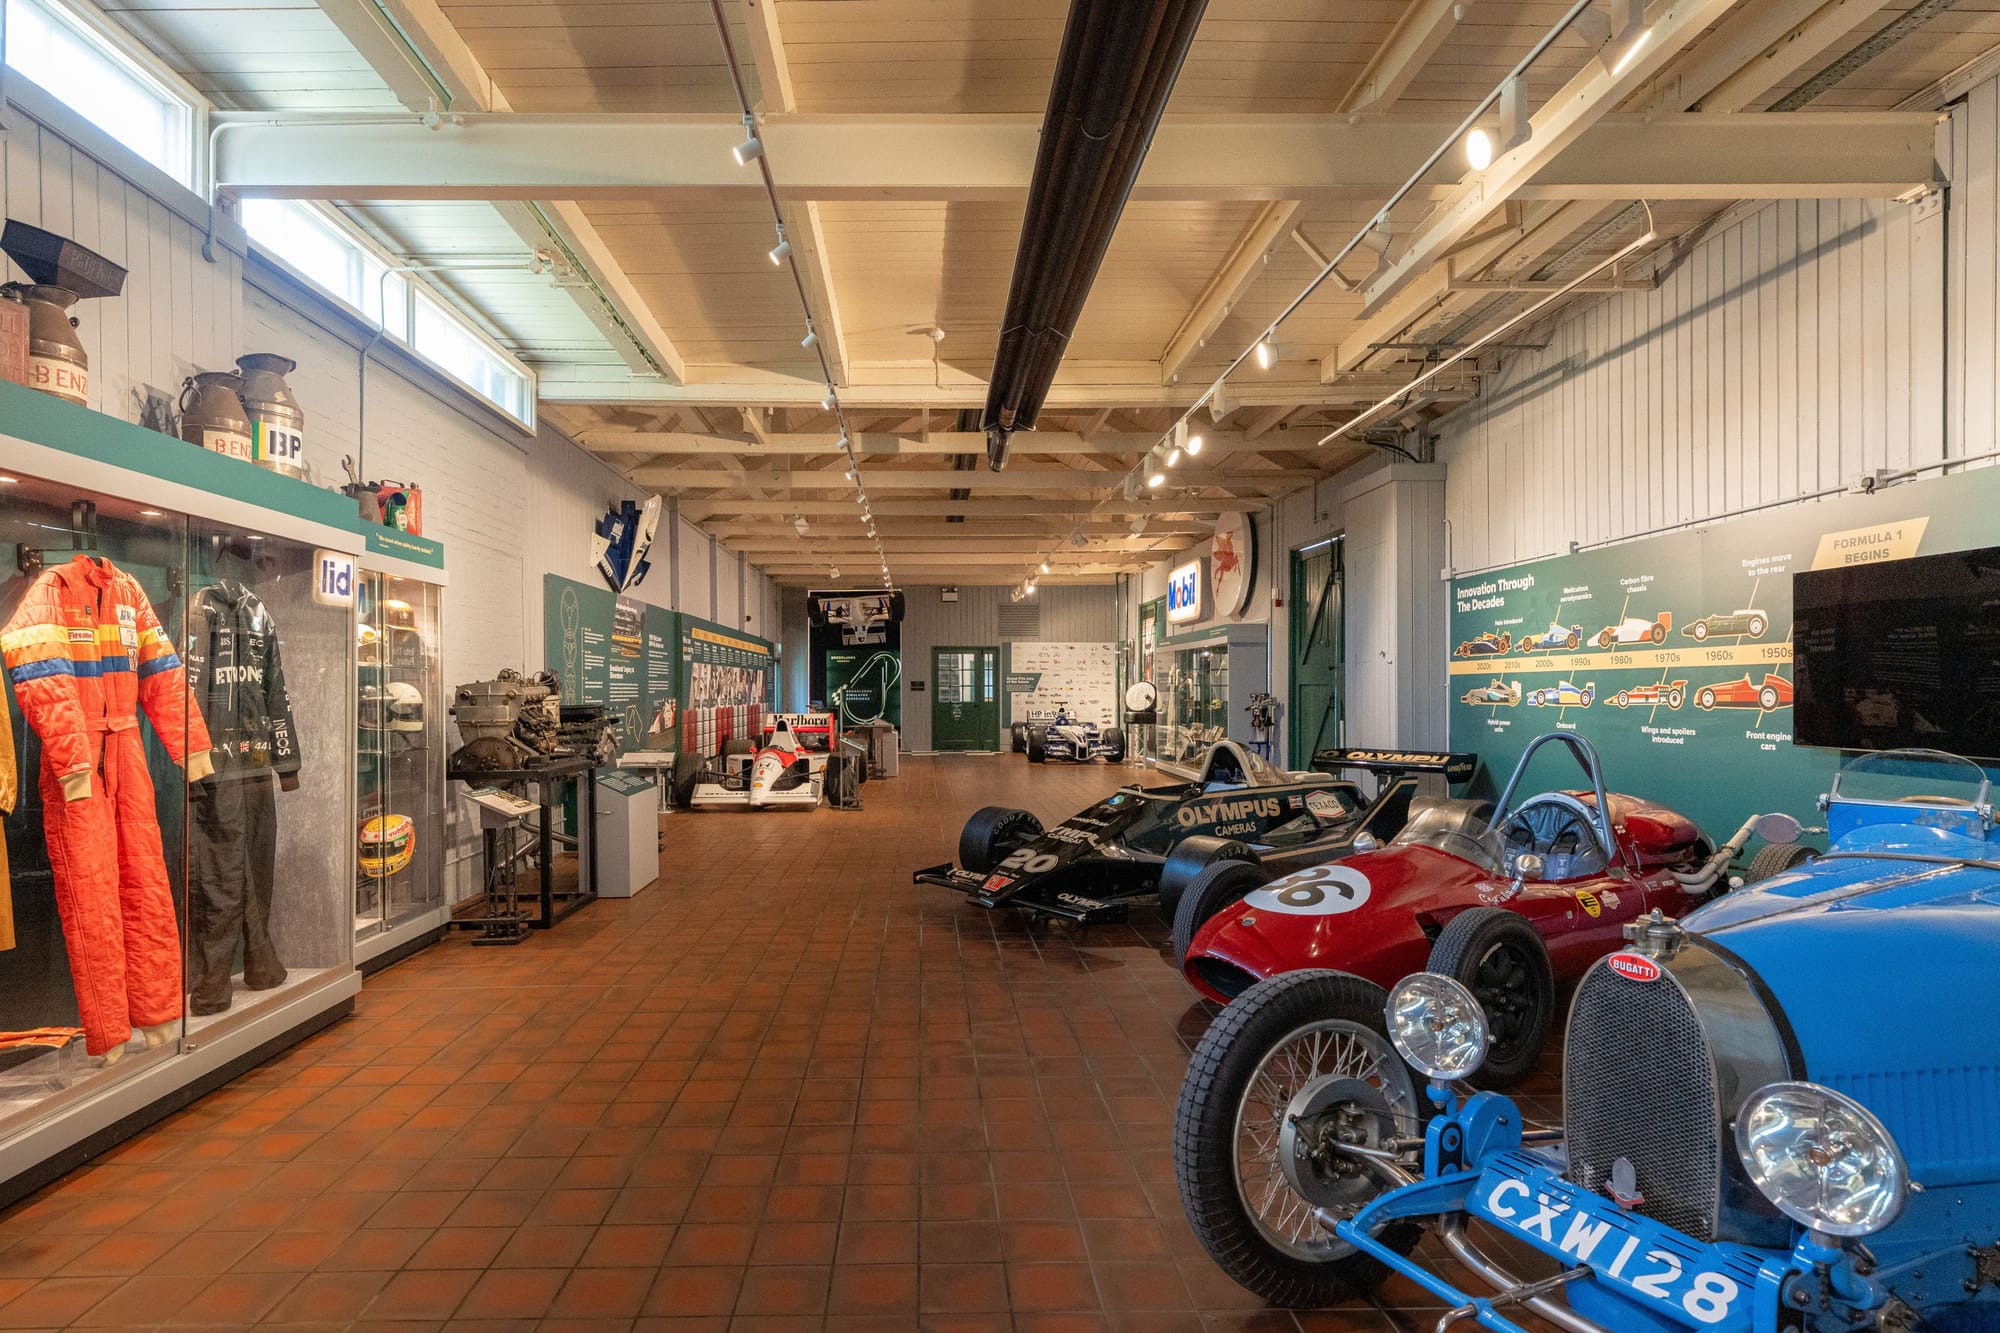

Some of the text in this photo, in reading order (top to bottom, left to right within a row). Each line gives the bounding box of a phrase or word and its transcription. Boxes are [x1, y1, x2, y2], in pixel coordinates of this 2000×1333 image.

[270, 430, 301, 459] BP
[1834, 529, 1902, 550] FORMULA 1
[1742, 553, 1792, 569] Engines move
[1845, 548, 1890, 563] BEGINS
[1747, 565, 1786, 577] to the rear
[1457, 574, 1535, 599] Innovation Through
[1620, 577, 1640, 586] Carbon
[1168, 572, 1195, 612] Mobil
[1457, 596, 1505, 613] The Decades
[1477, 647, 1793, 670] 2020s 2010s 2000s 1990s 1980s 1970s 1960s 1950s
[273, 719, 291, 756] INEOS
[1641, 726, 1659, 735] Wings
[1672, 728, 1696, 736] spoilers
[1652, 736, 1684, 744] introduced
[1746, 731, 1792, 742] Front engine
[1177, 797, 1281, 827] OLYMPUS
[1308, 799, 1340, 810] TEXACO
[1215, 821, 1257, 837] CAMERAS
[1000, 848, 1058, 873] 20
[1260, 868, 1354, 907] 36
[1613, 959, 1654, 978] BUGATTI
